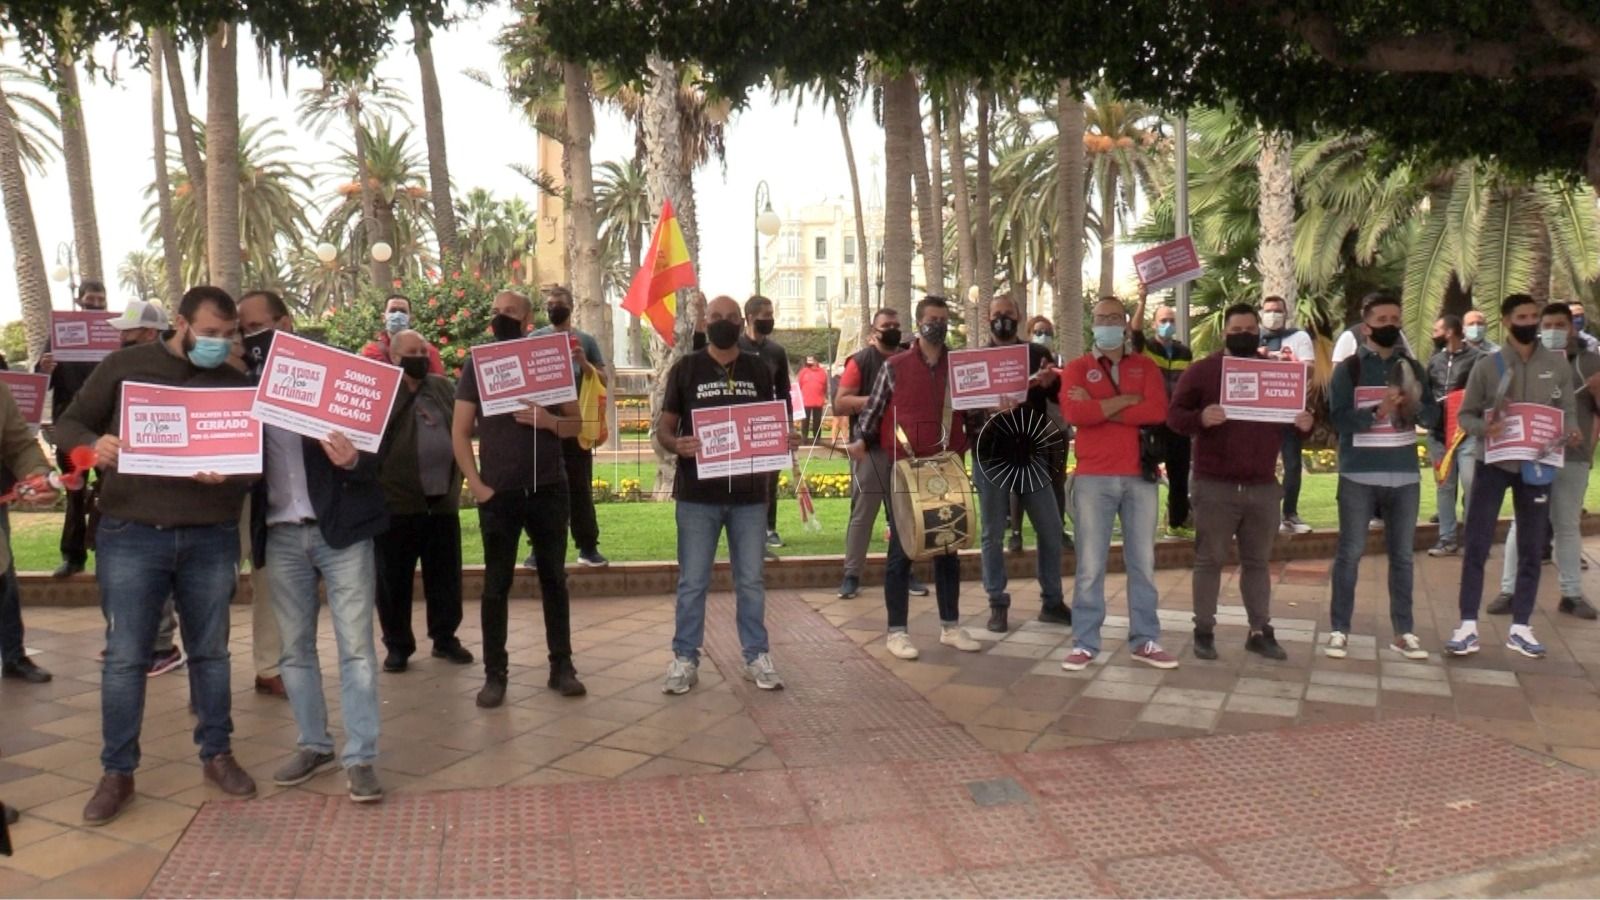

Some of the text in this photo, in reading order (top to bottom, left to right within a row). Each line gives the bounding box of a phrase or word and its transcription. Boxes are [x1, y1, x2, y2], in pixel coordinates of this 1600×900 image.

[276, 363, 320, 381] SIN AYUDAS
[344, 368, 377, 386] SOMOS
[272, 383, 317, 403] Arruinan!
[334, 379, 382, 400] PERSONAS
[1264, 388, 1296, 398] ALTURA
[334, 392, 372, 410] NO MÁS
[134, 412, 181, 422] SIN AYUDAS
[328, 403, 372, 422] ENGAÑOS
[196, 419, 248, 430] CERRADO
[136, 432, 182, 443] Arruinan!
